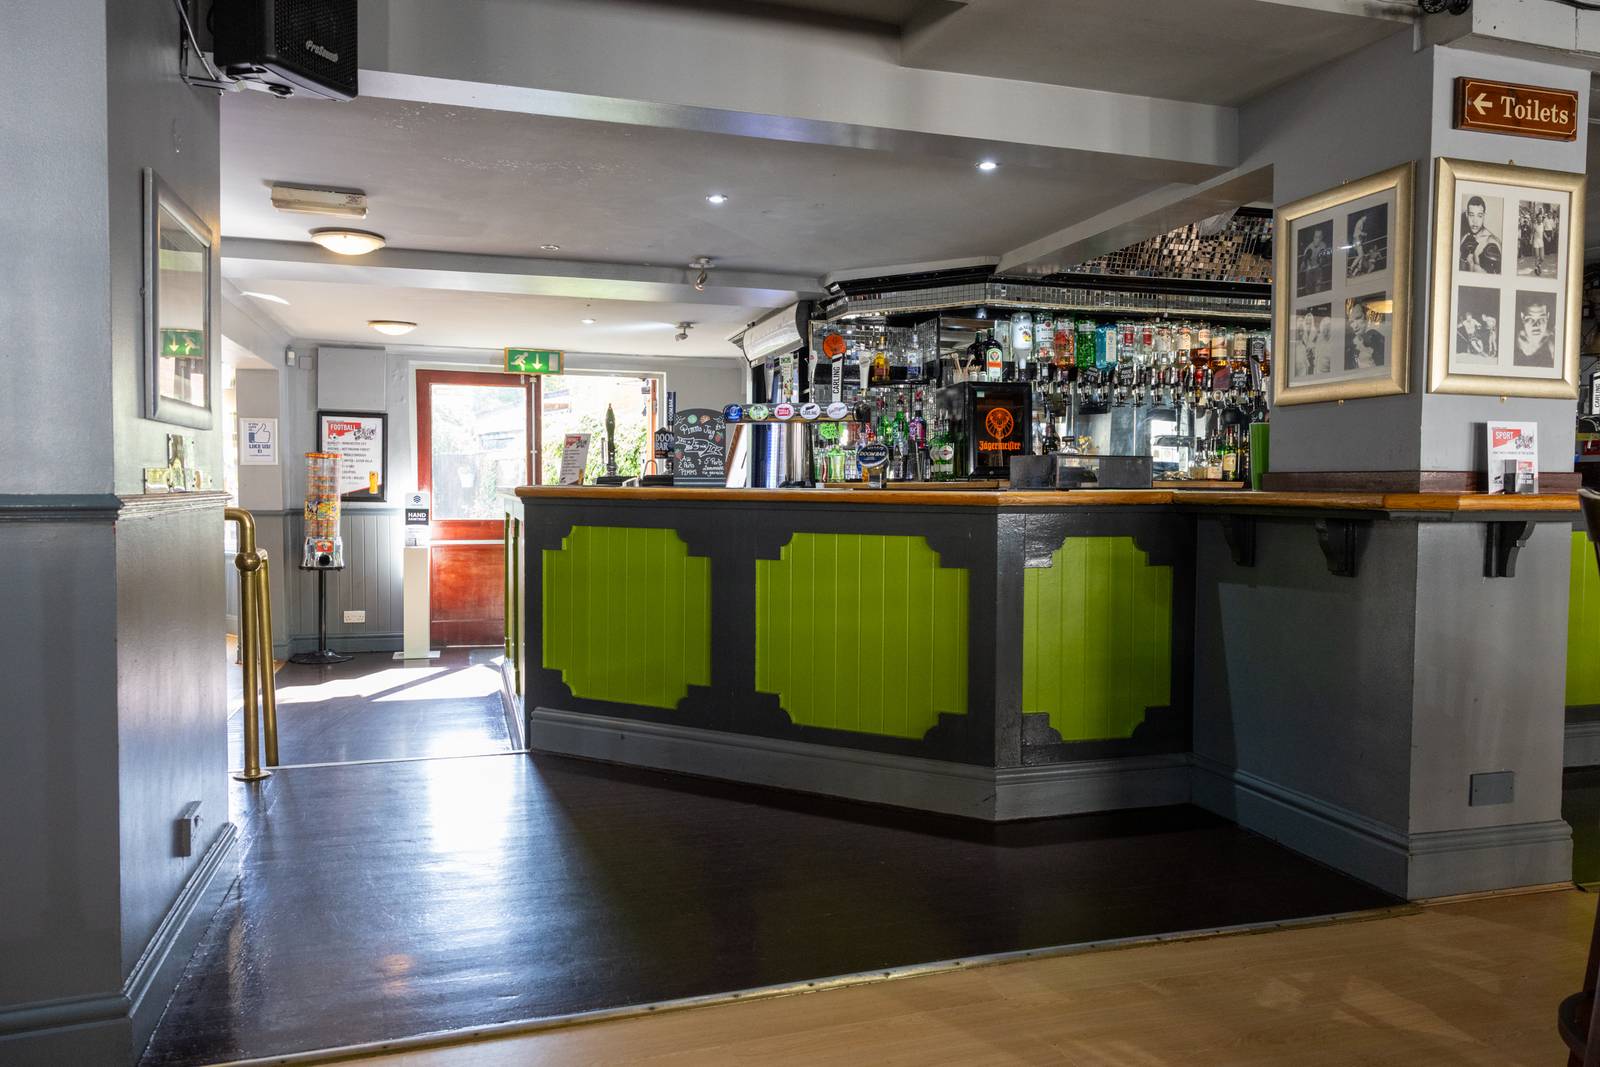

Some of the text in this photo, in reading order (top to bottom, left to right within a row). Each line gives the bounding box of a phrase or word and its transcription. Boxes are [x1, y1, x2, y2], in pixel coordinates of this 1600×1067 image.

[1500, 96, 1569, 124] Toilets
[833, 366, 841, 394] CARLING
[330, 423, 356, 431] FOOTBALL
[1495, 431, 1513, 440] SPORT
